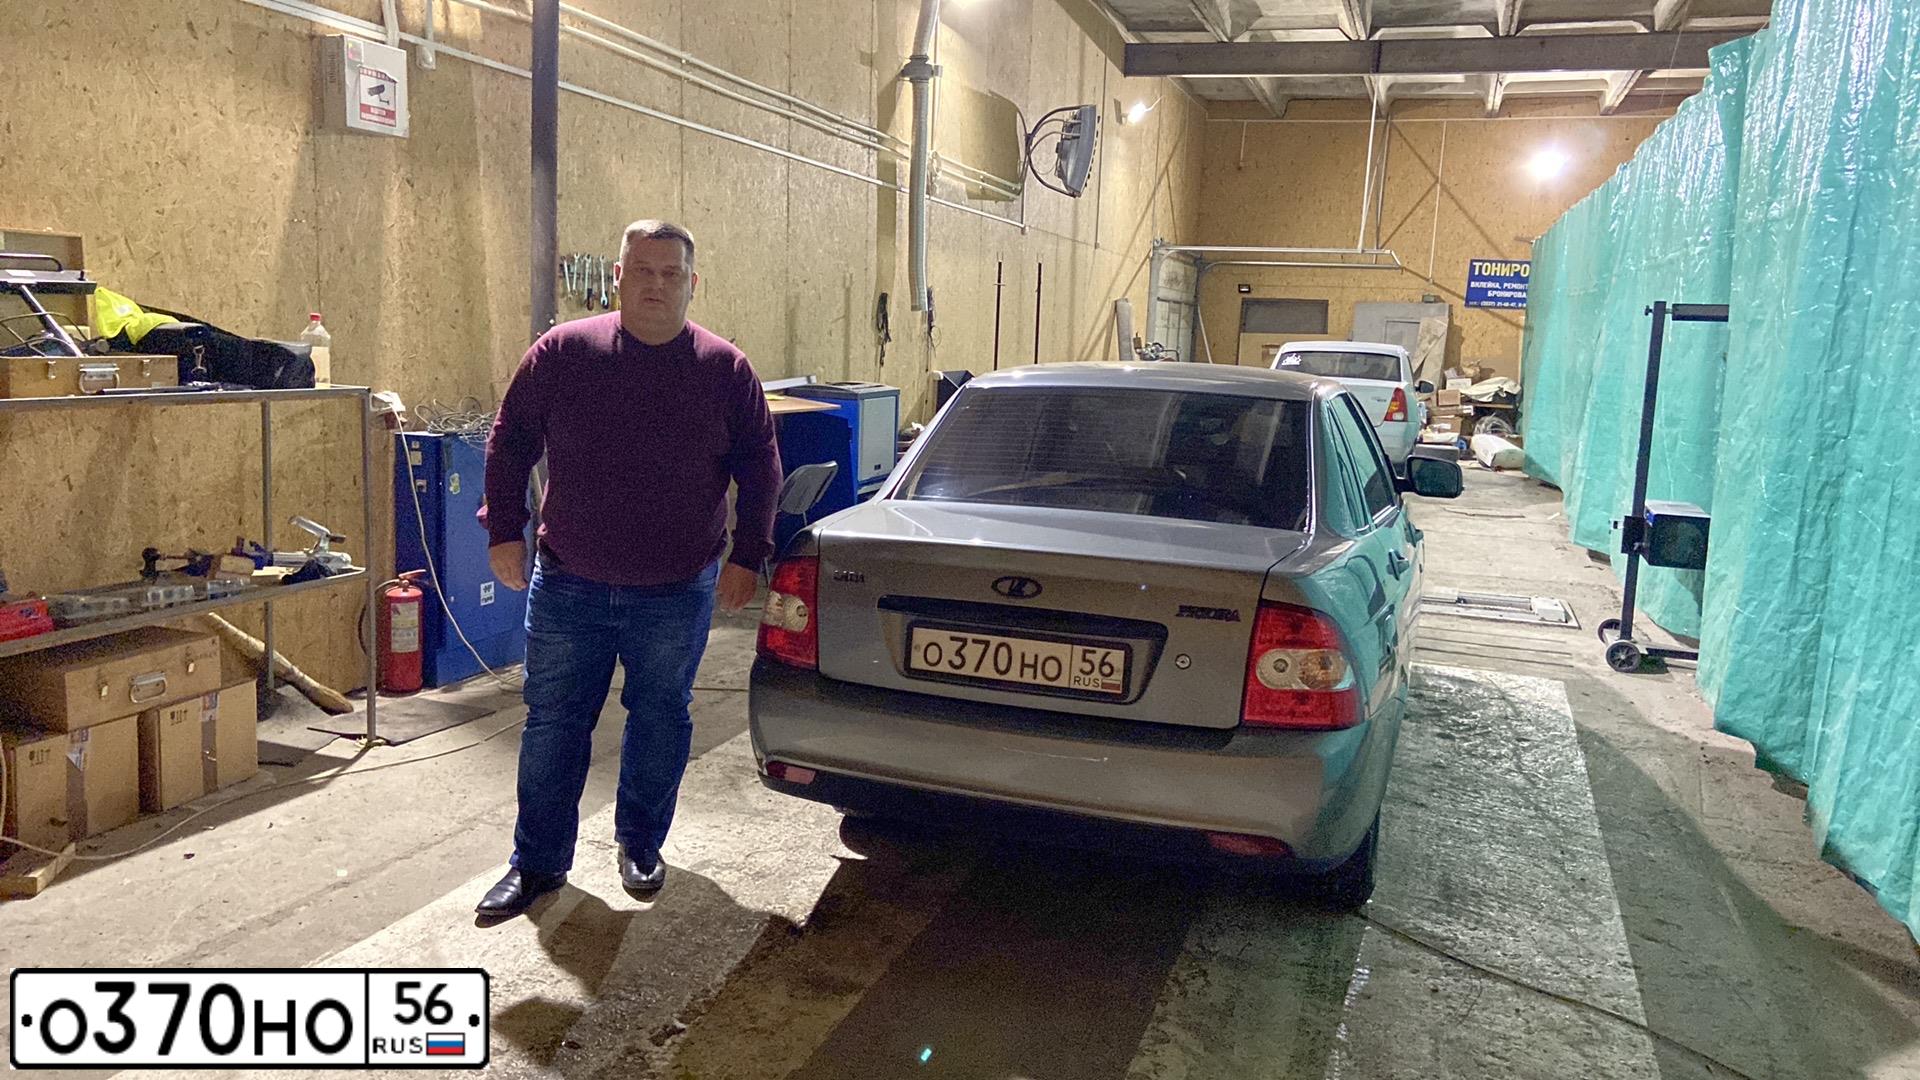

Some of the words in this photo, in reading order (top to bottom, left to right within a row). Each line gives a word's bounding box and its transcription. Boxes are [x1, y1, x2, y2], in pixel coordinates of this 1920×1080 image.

[1472, 262, 1530, 277] ТОНИРО
[1079, 649, 1115, 678] 56
[1073, 675, 1100, 687] RUS
